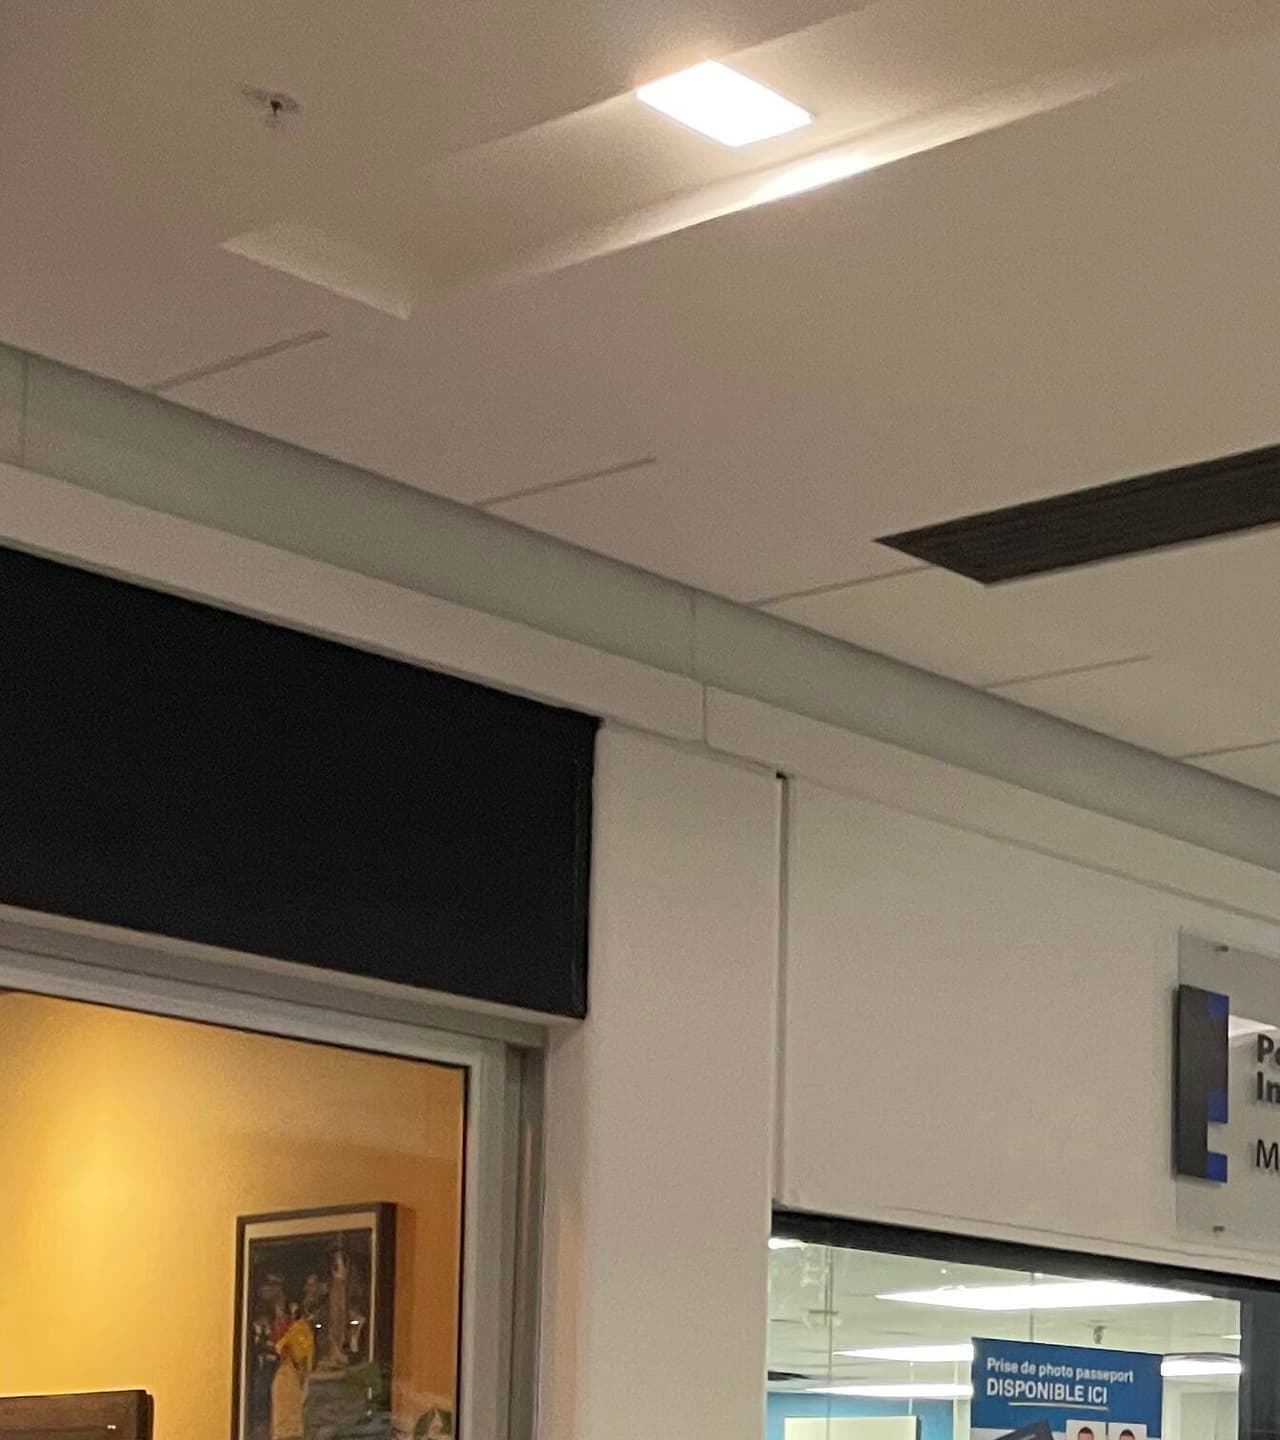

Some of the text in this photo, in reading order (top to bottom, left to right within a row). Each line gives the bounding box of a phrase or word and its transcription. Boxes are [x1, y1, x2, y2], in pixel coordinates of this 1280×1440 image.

[986, 1357, 1134, 1383] Prise de photo passeport
[986, 1378, 1108, 1404] DISPONIBLE ICI
